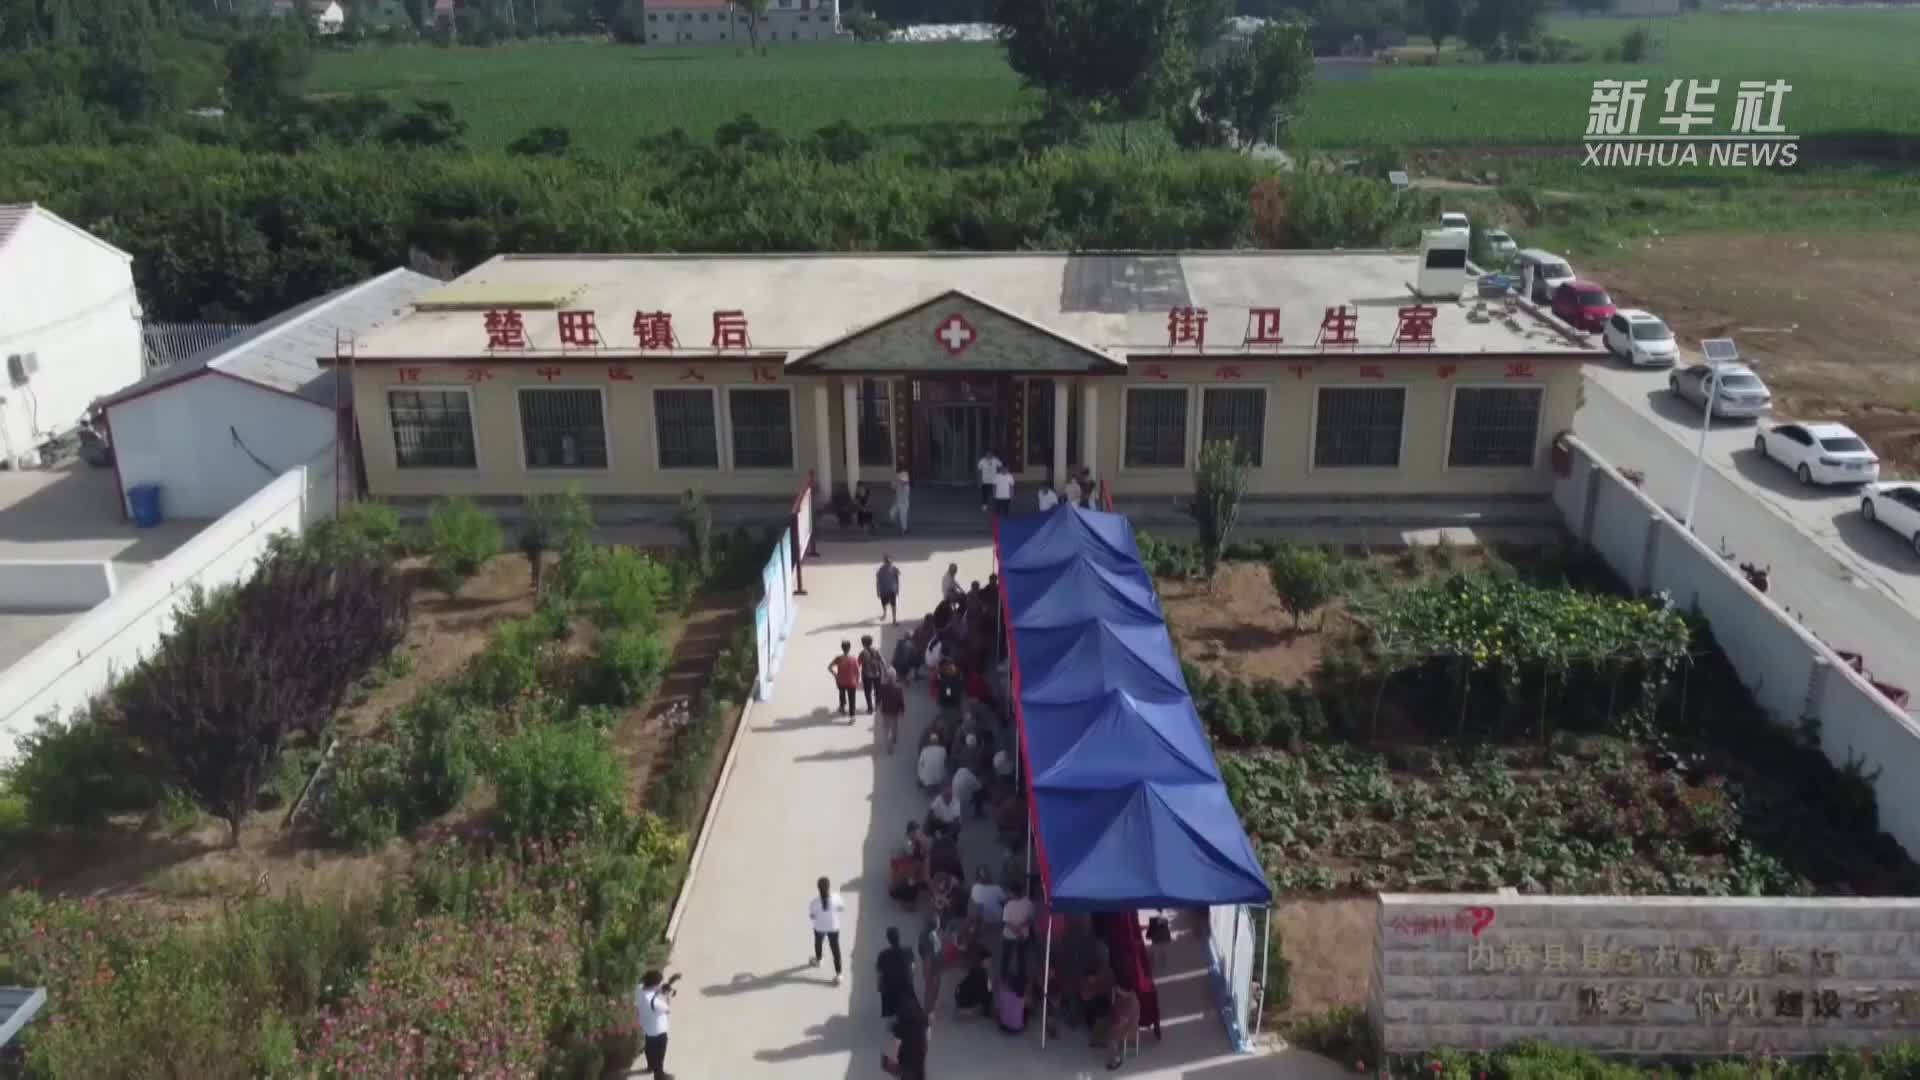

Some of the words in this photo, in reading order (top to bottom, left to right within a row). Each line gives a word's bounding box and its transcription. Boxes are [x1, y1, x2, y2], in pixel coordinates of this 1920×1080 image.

[483, 309, 750, 350] 楚旺镇后
[1167, 305, 1438, 346] 街卫生室
